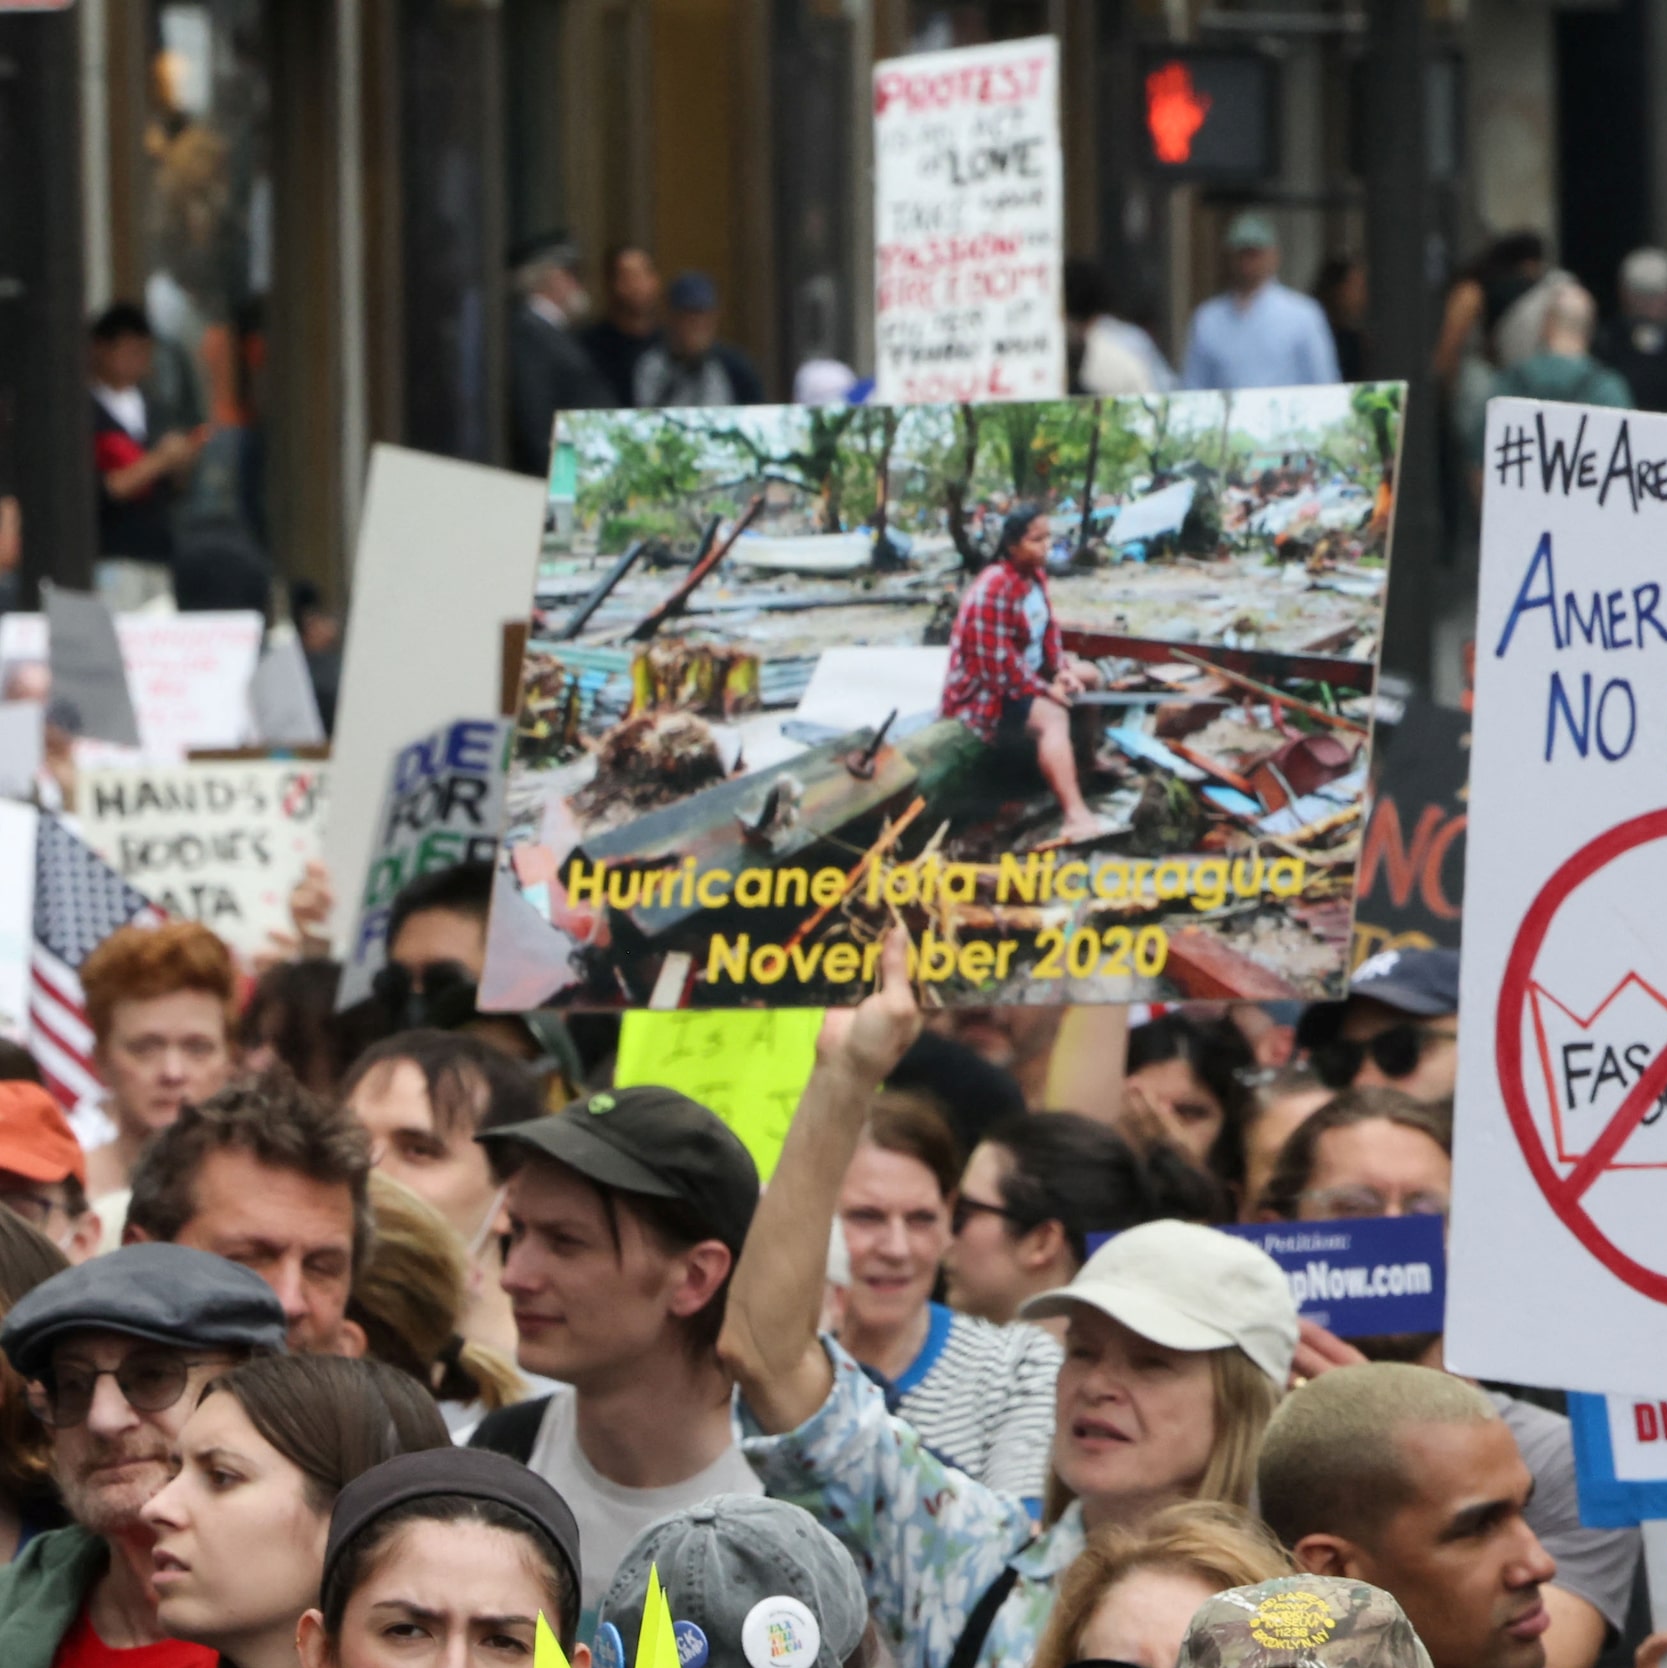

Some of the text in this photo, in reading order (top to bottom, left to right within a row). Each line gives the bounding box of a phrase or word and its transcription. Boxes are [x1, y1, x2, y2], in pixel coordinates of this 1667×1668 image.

[1544, 670, 1637, 764] NO
[95, 780, 267, 820] HANDS
[119, 831, 272, 877] BODIES
[566, 856, 849, 910] Hurricane
[867, 853, 977, 906] Iota
[997, 850, 1306, 911] Nicaragua
[1032, 924, 1169, 980] 2020
